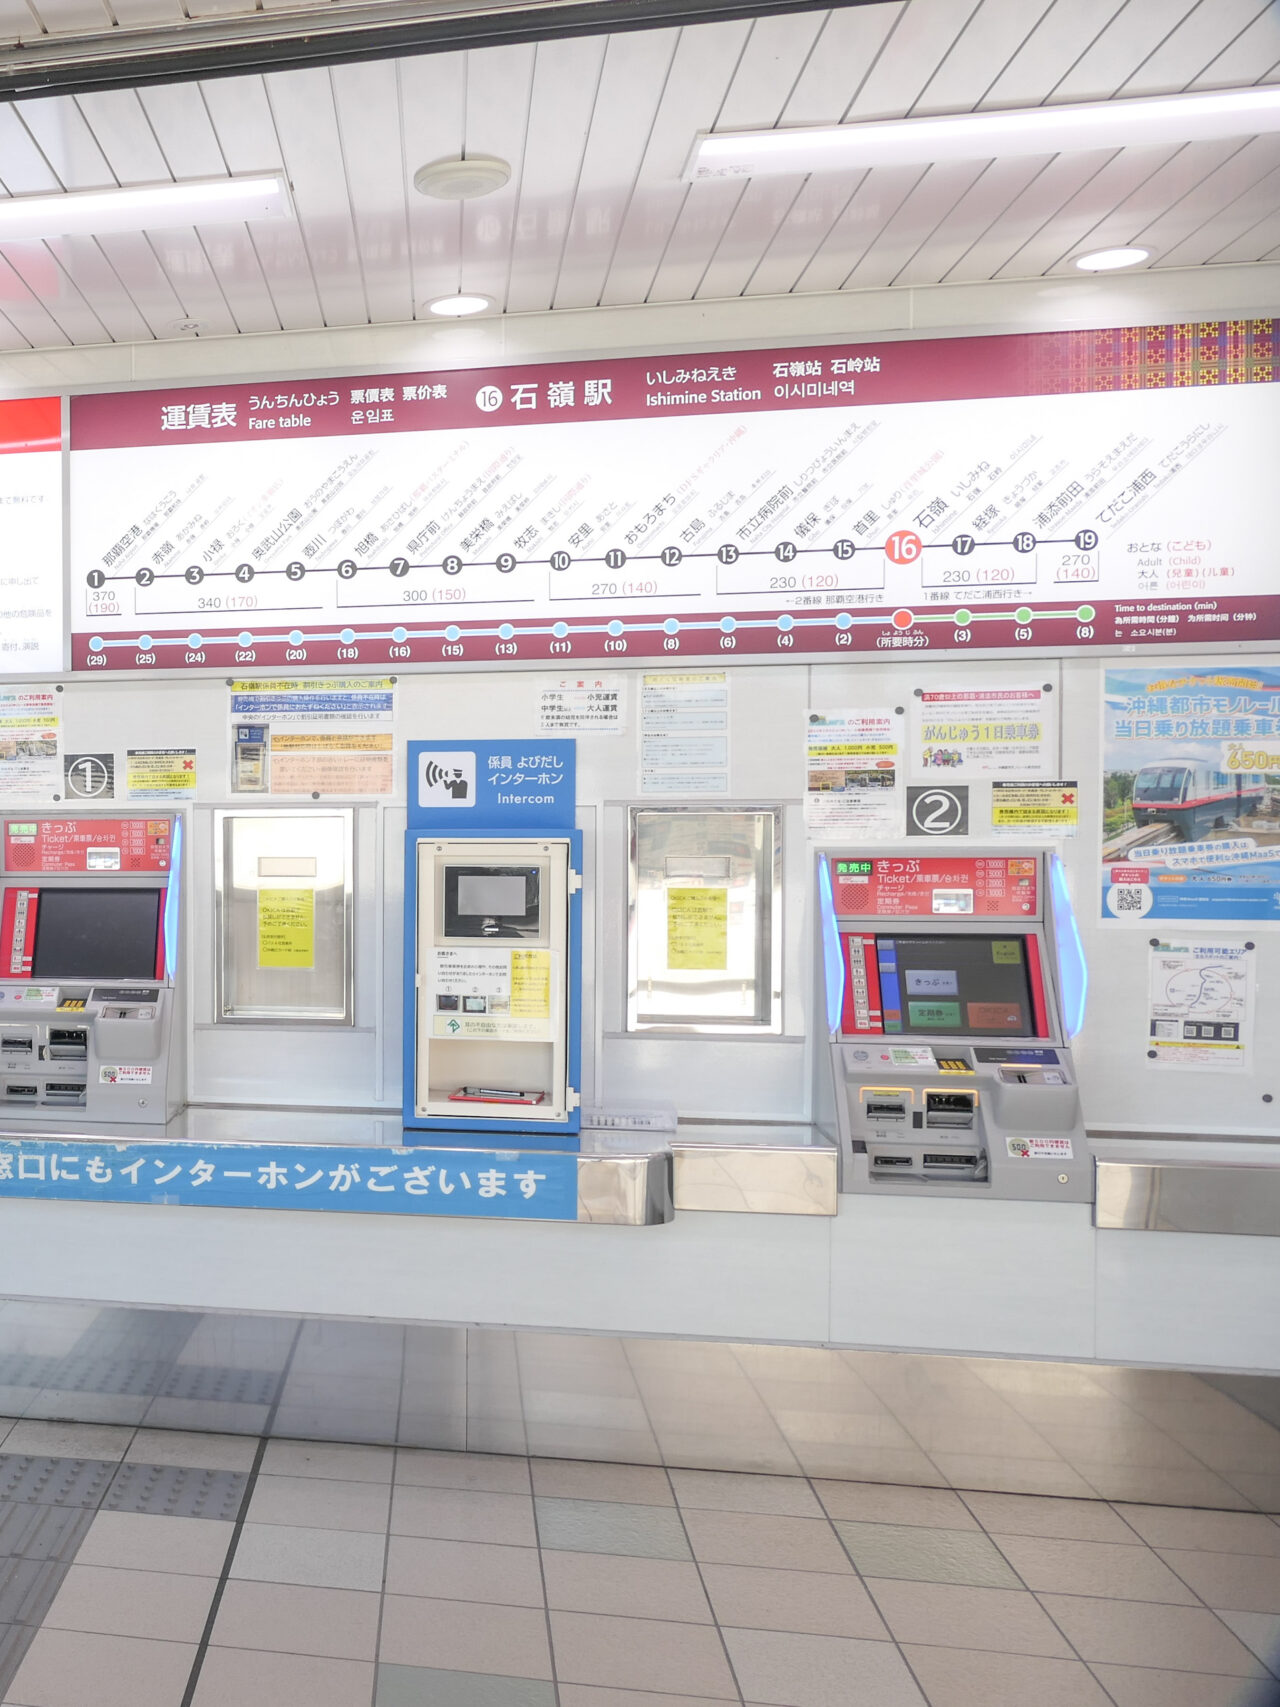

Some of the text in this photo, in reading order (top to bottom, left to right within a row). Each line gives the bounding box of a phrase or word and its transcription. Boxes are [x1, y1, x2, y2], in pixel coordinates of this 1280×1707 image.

[772, 356, 880, 378] 石嶺站 石岭站
[646, 365, 737, 386] いしみねえき
[350, 384, 447, 404] 票價表 票价表
[510, 378, 613, 410] 石嶺駅
[774, 380, 855, 399] 이시미네역
[248, 390, 340, 410] うんちんひょう
[646, 387, 761, 407] Ishimine Station
[161, 402, 237, 431] 運賃表
[249, 414, 311, 430] Fare table
[351, 408, 394, 424] 운임표
[1094, 422, 1211, 524] てだこ浦西 てだこうらにし
[912, 460, 991, 529] 石嶺 いしみね
[1032, 480, 1085, 530] 浦添前田
[624, 493, 676, 545] おもろまち
[735, 484, 794, 541] 市立病院前
[971, 503, 1000, 531] 経塚
[793, 511, 822, 539] 儀保
[851, 509, 880, 537] 首里
[251, 508, 303, 561] 奥武山公園
[458, 516, 495, 553] 美栄橋
[512, 524, 540, 550] 牧志
[567, 522, 595, 549] 安里
[679, 517, 706, 544] 古島
[354, 531, 379, 557] 旭橋
[405, 520, 441, 556] 県庁前
[955, 537, 972, 553] 17
[1016, 534, 1033, 551] 18
[1078, 532, 1095, 546] 19
[151, 540, 176, 565] 赤嶺
[202, 538, 225, 563] 小禄
[779, 545, 794, 560] 14
[836, 542, 852, 558] 15
[892, 535, 916, 559] 16
[1127, 539, 1212, 552] おとな (こども)
[554, 553, 567, 568] 10
[609, 552, 622, 566] 11
[665, 549, 679, 564] 12
[721, 547, 736, 562] 13
[1061, 554, 1090, 566] 270
[1138, 556, 1202, 567] Adult (Child)
[342, 562, 352, 577] 6
[394, 560, 404, 574] 7
[447, 558, 458, 573] 8
[501, 556, 511, 570] 9
[141, 570, 150, 584] 2
[191, 569, 199, 582] 3
[239, 567, 250, 581] 4
[291, 565, 300, 578] 5
[943, 567, 1015, 582] 230 (120)
[1056, 567, 1096, 580] (140)
[1138, 570, 1158, 579] 大人
[93, 573, 99, 586] 1
[770, 574, 839, 589] 230 (120)
[1138, 580, 1206, 591] 어른 (어린이)
[403, 587, 466, 602] 300 (150)
[591, 580, 658, 595] 270 (140)
[954, 589, 1024, 600] てだこ浦西行き
[92, 591, 116, 601] 370
[198, 596, 258, 609] 340 (170)
[88, 602, 120, 614] (190)
[1147, 602, 1192, 611] destination
[1194, 601, 1217, 611] (min)
[953, 629, 972, 642] (3)
[1014, 627, 1033, 641] (5)
[1076, 625, 1095, 639] (8)
[604, 639, 627, 652] (10)
[663, 637, 680, 650] (8)
[719, 636, 736, 649] (6)
[777, 634, 794, 647] (4)
[835, 633, 852, 646] (2)
[876, 636, 929, 648] (所要時分)
[337, 647, 359, 660] (18)
[389, 645, 411, 658] (16)
[441, 644, 464, 656] (15)
[495, 642, 518, 655] (13)
[549, 641, 572, 653] (11)
[86, 654, 106, 666] (29)
[135, 653, 156, 665] (25)
[185, 652, 206, 664] (24)
[235, 650, 256, 662] (22)
[285, 648, 307, 661] (20)
[541, 693, 564, 701] 小学生
[1114, 719, 1280, 737] 当日乗り放題乗車
[487, 756, 563, 769] 係員 よびだし
[488, 773, 563, 785] インターホン
[497, 792, 555, 804] Intercom
[41, 822, 77, 833] きっぷ
[837, 863, 872, 873] 発売中
[876, 860, 920, 872] きっぷ
[915, 978, 940, 986] きっぷ
[918, 1009, 944, 1017] 定期券
